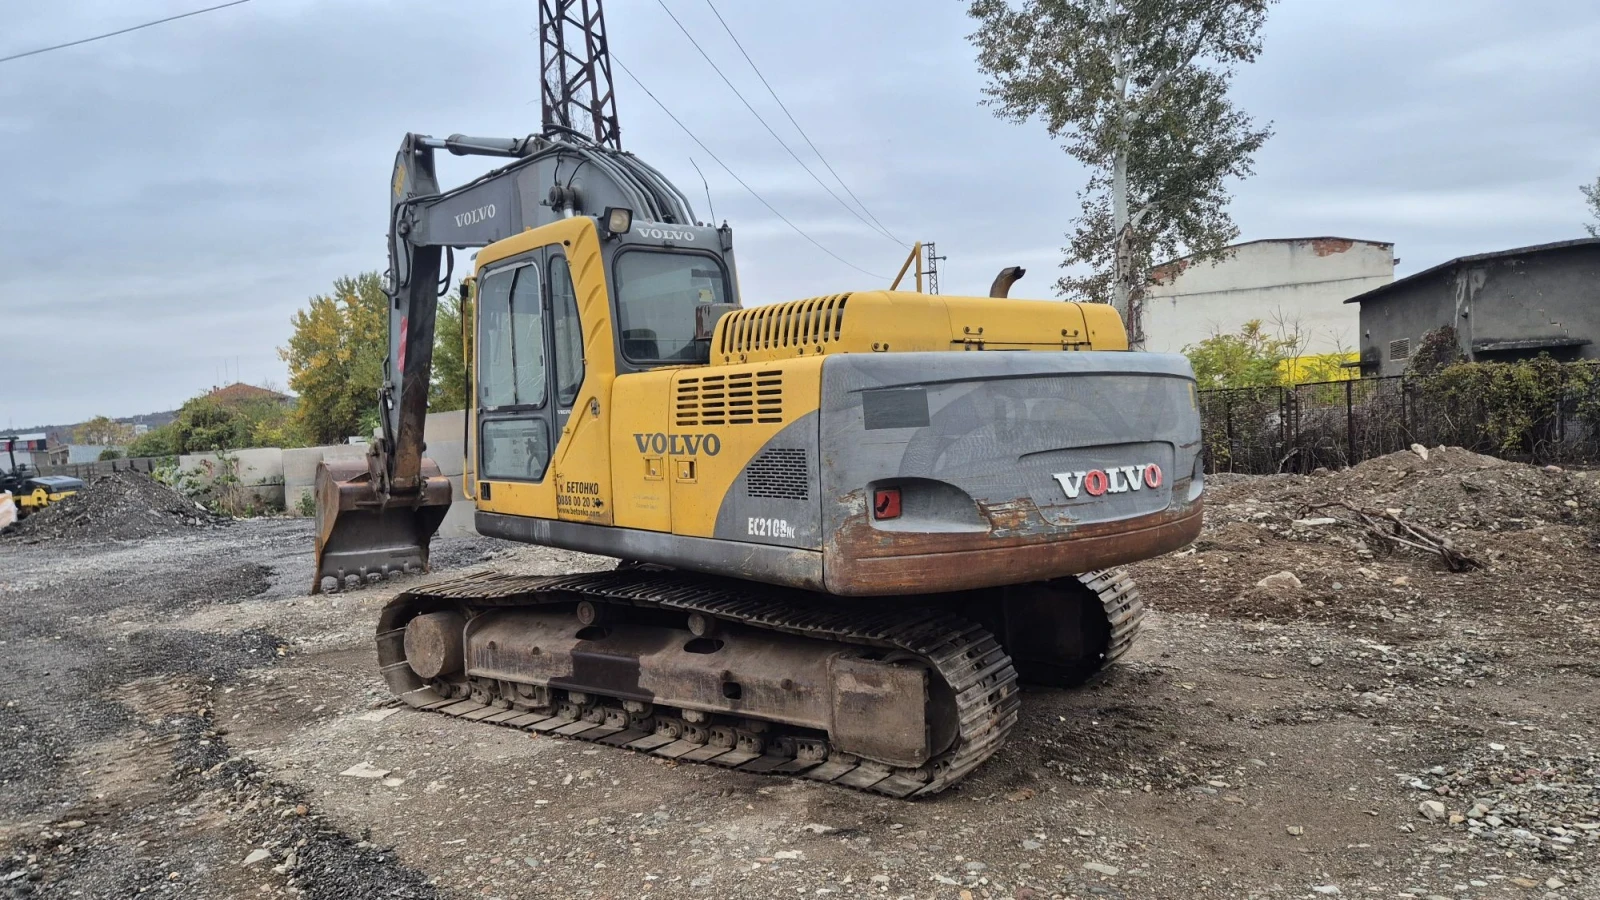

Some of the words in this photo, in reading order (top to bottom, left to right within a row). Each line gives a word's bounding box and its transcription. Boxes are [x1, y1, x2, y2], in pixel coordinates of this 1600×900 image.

[454, 204, 496, 227] VOLVO
[636, 227, 695, 241] VOLVO
[633, 433, 721, 456] VOLVO
[566, 481, 599, 495] БЕТОНКО
[1051, 463, 1163, 498] VOLVO
[573, 496, 581, 506] 00
[582, 497, 590, 507] 20
